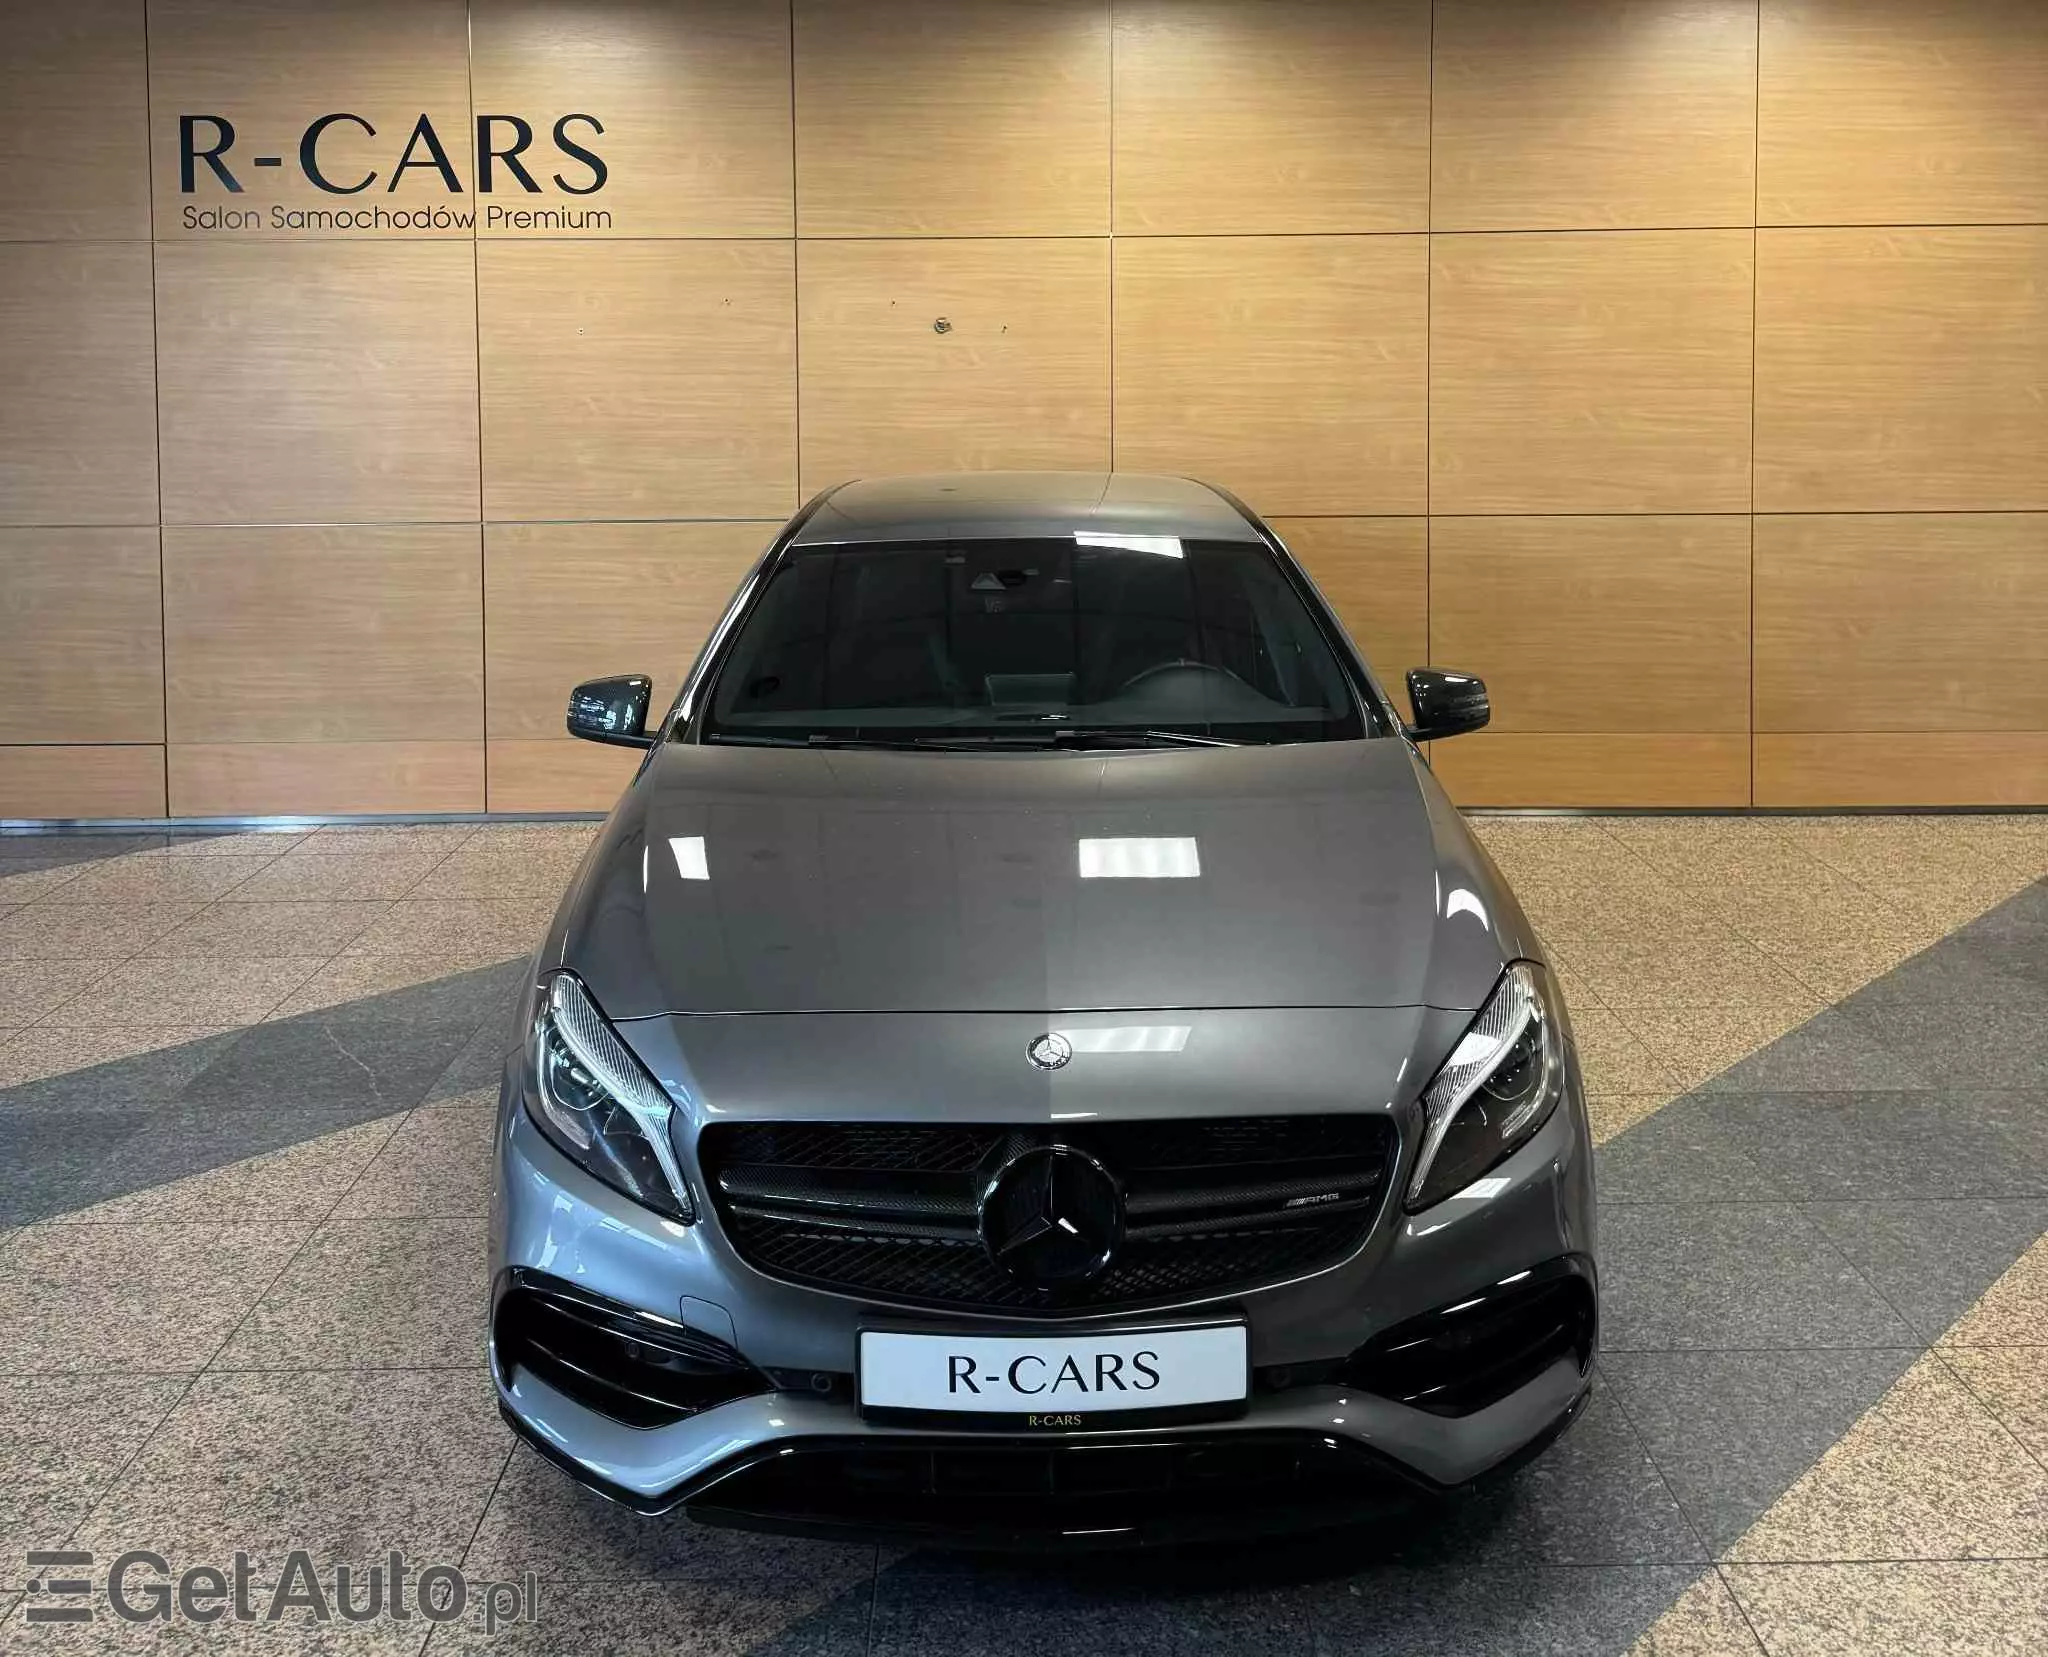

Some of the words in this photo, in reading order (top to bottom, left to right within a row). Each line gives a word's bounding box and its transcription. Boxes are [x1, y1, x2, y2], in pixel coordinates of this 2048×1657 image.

[180, 113, 608, 195] R-CARS
[183, 205, 260, 230] Salon
[271, 205, 476, 230] Samochodów
[487, 205, 612, 230] Premium
[948, 1351, 1160, 1395] R-CARS
[1028, 1414, 1082, 1427] R-CARS
